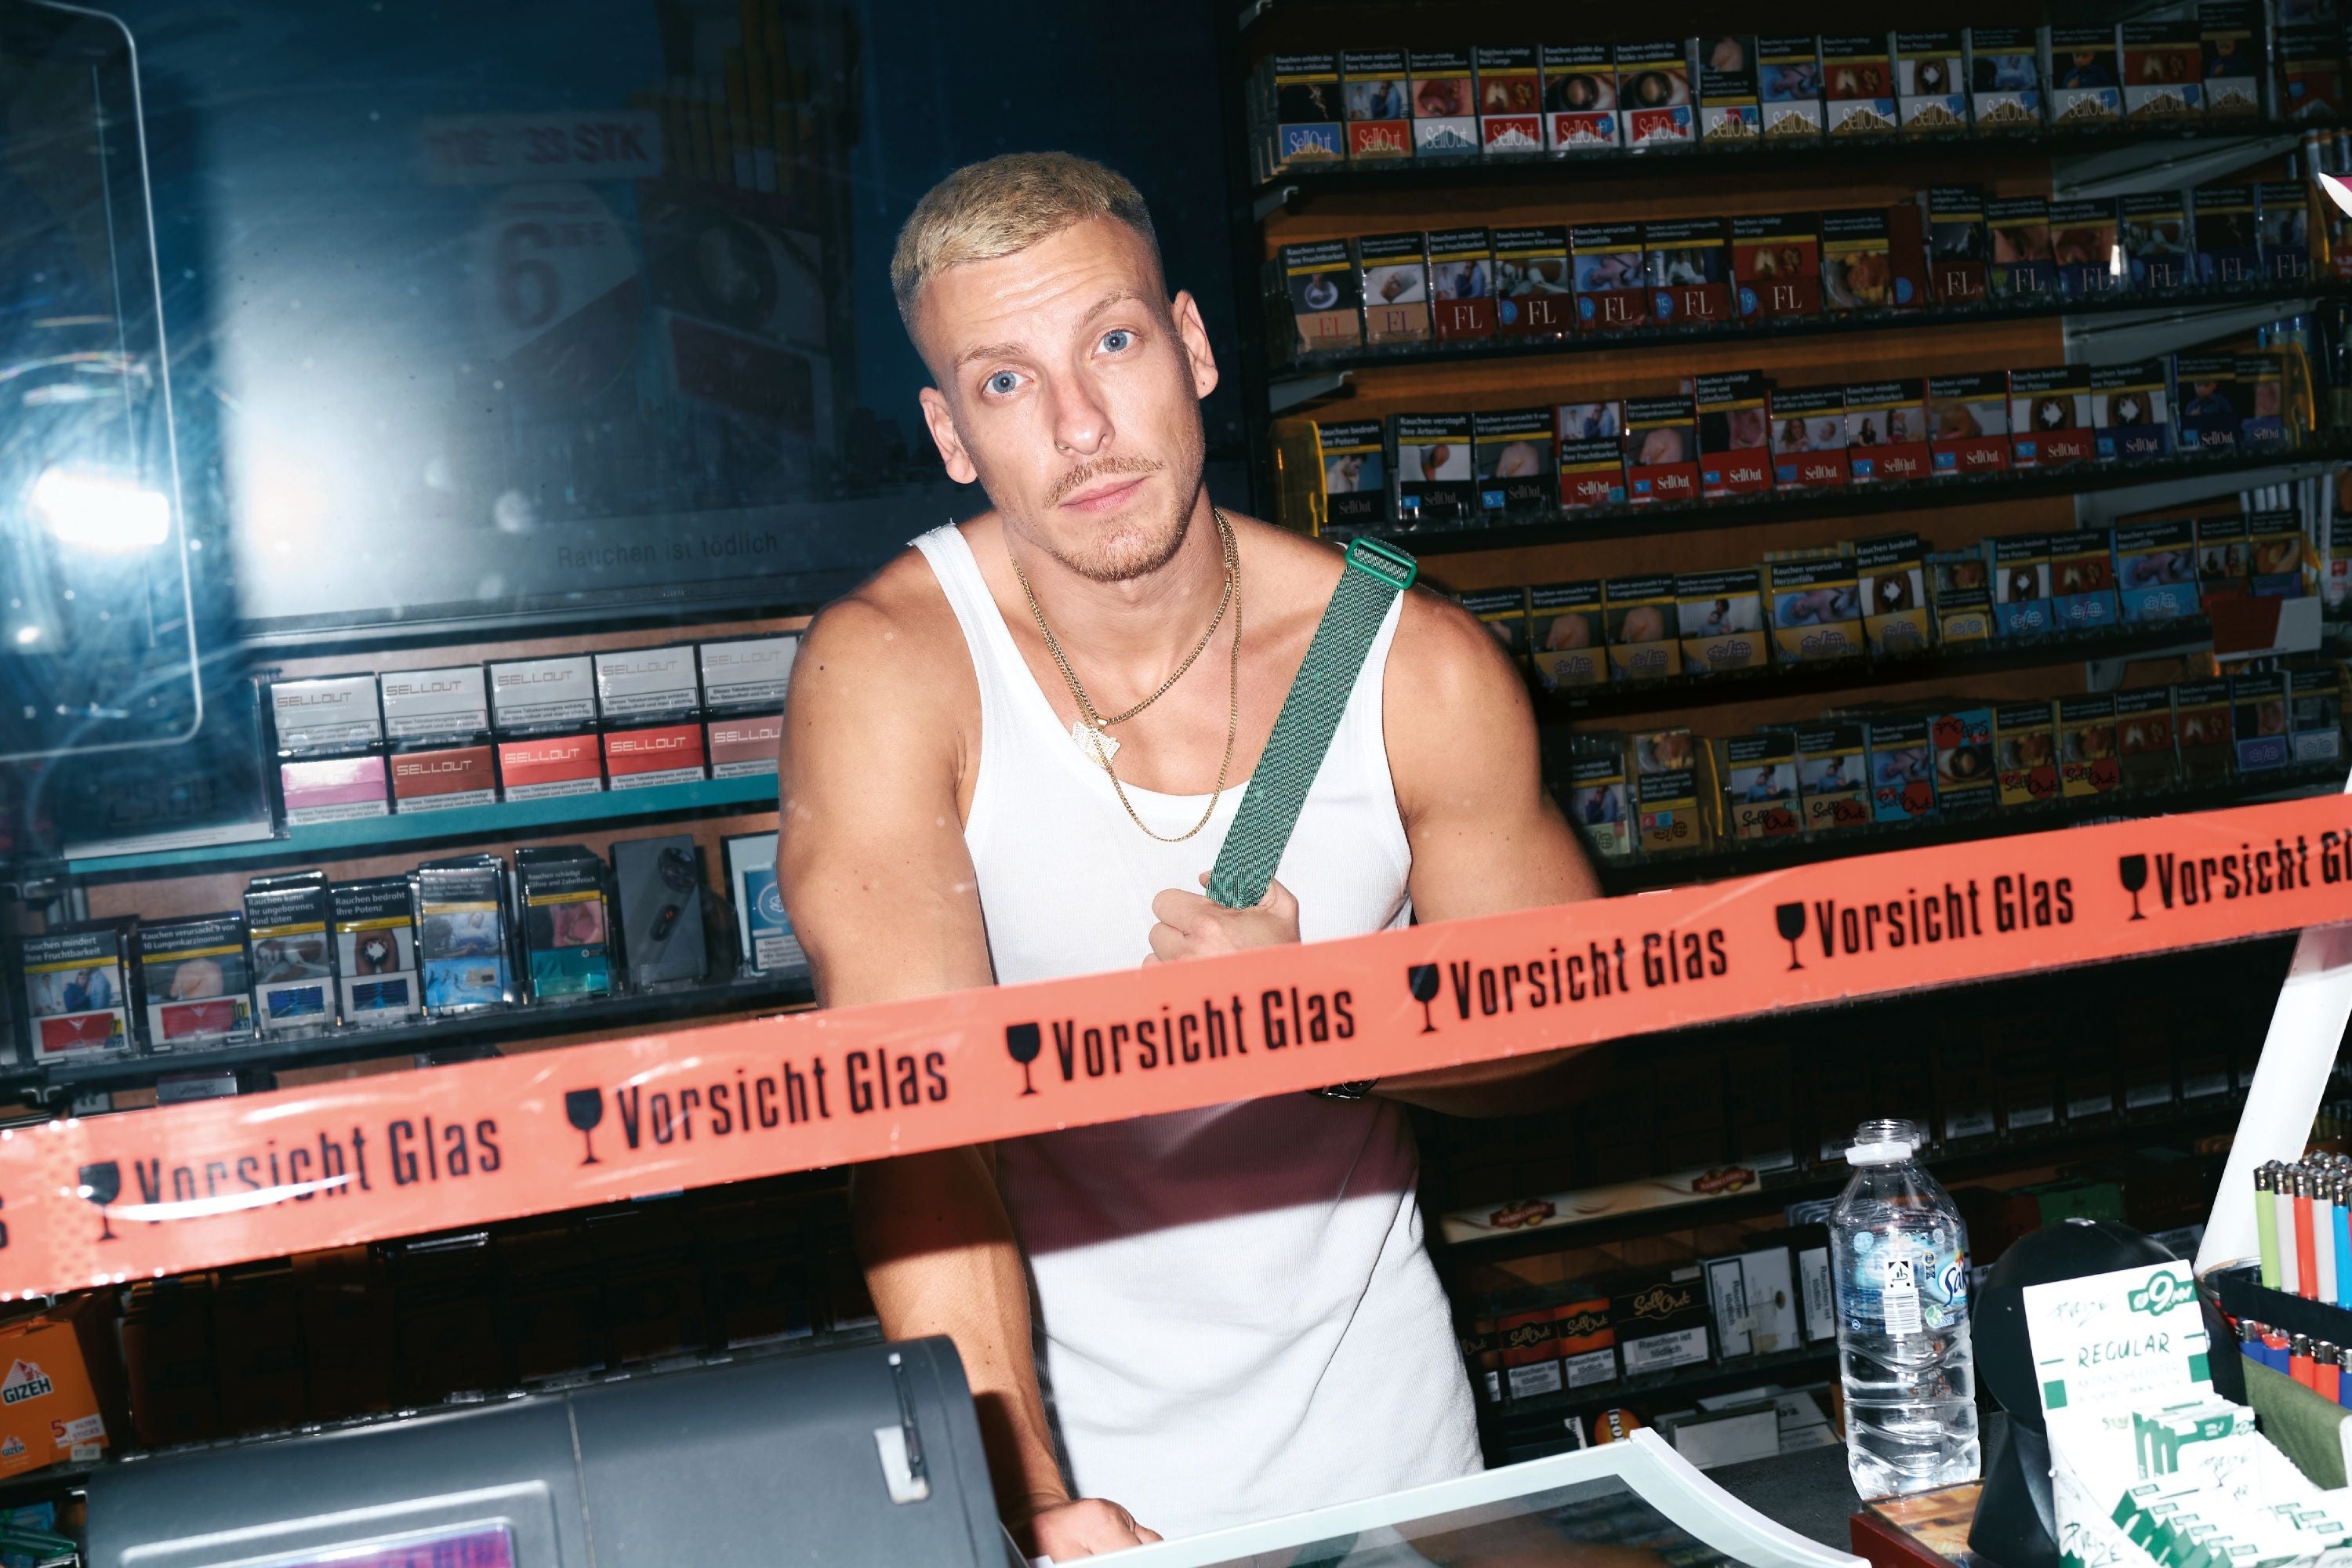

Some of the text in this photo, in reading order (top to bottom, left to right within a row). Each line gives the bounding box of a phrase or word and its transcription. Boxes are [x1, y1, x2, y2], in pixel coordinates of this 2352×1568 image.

[1773, 110, 1816, 134] SellOut
[1843, 106, 1886, 131] SellOut
[1493, 121, 1535, 147] SellOut
[1561, 118, 1604, 143] SellOut
[1639, 116, 1681, 142] SellOut
[1290, 129, 1332, 154] SellOut
[1359, 128, 1402, 153] SellOut
[1425, 125, 1468, 151] SellOut
[2221, 258, 2249, 282] FL
[2277, 254, 2304, 278] FL
[1946, 271, 1975, 296] FL
[2014, 268, 2043, 292] FL
[2082, 267, 2111, 292] FL
[2149, 263, 2178, 288] FL
[1685, 291, 1712, 315] FL
[1773, 285, 1802, 310] FL
[1454, 305, 1483, 330] FL
[1527, 301, 1556, 325] FL
[1604, 297, 1633, 321] FL
[1400, 416, 1466, 426] Rauchen verstopft
[1320, 427, 1350, 436] auchen
[2201, 431, 2234, 446] SellOut
[2047, 443, 2081, 458] SellOut
[2125, 438, 2158, 452] SellOut
[1966, 449, 1999, 465] SellOut
[1806, 466, 1838, 481] SellOut
[1884, 458, 1917, 474] SellOut
[1657, 475, 1690, 490] SellOut
[1730, 468, 1762, 483] SellOut
[1508, 485, 1541, 500] SellOut
[1577, 481, 1610, 495] SellOut
[1339, 500, 1371, 515] SellOut
[1425, 491, 1457, 507] SellOut
[557, 545, 656, 569] Rauchen
[702, 531, 778, 558] tödlich
[1857, 539, 1918, 556] Rauchen bedroht
[1773, 565, 1803, 577] Rauchen
[706, 651, 782, 666] SELLOUT
[602, 660, 677, 677] SELLOUT
[498, 670, 572, 687] SELLOUT
[387, 681, 461, 696] SELLOUT
[277, 692, 351, 707] SELLOUT
[714, 728, 780, 743] SELLOU
[611, 737, 686, 753] SELLOUT
[505, 749, 580, 764] SELLOUT
[397, 760, 472, 775] SELLOUT
[555, 869, 580, 879] schädigt
[2155, 829, 2352, 909] Vorsicht Gl
[528, 879, 547, 887] Zähne
[561, 876, 596, 885] Zahnfleisch
[249, 894, 303, 906] Rauchen kann
[336, 891, 405, 906] Rauchen bedroht
[263, 902, 314, 916] ungeborenes
[336, 904, 383, 916] Ihre Potenz
[1815, 873, 2074, 958] Vorsicht Glas
[250, 914, 292, 926] Kind töten
[142, 931, 173, 941] Rauchen
[175, 926, 214, 938] verursacht
[154, 935, 225, 949] Lungenkarzinomen
[24, 936, 96, 953] Rauchen mindert
[24, 947, 101, 963] Ihre Fruchtbarkeit
[1450, 928, 1728, 1019] Vorsicht Glas
[1052, 988, 1356, 1082] Vorsicht Glas
[617, 1048, 949, 1149] Vorsicht Glas
[135, 1117, 502, 1224] Vorsicht Glas
[1820, 1265, 1830, 1304] Rauchen
[1633, 1289, 1692, 1316] SellOut
[1813, 1279, 1821, 1311] tödlich
[1725, 1294, 1735, 1326] tödlich
[1568, 1313, 1609, 1335] SellOut
[1509, 1326, 1552, 1346] SellOut
[1639, 1332, 1692, 1350] Rauchen ist
[1650, 1344, 1682, 1358] tödlich
[2078, 1333, 2171, 1368] REGULAR
[1568, 1352, 1612, 1367] Rauchen ist
[1577, 1363, 1604, 1373] tödlich
[1511, 1366, 1546, 1377] Rauchen
[3, 1377, 52, 1403] GIZEH
[51, 1418, 67, 1438] 5
[74, 1418, 97, 1430] FILTER
[73, 1428, 100, 1439] STICKS
[2, 1444, 26, 1457] GIZEH
